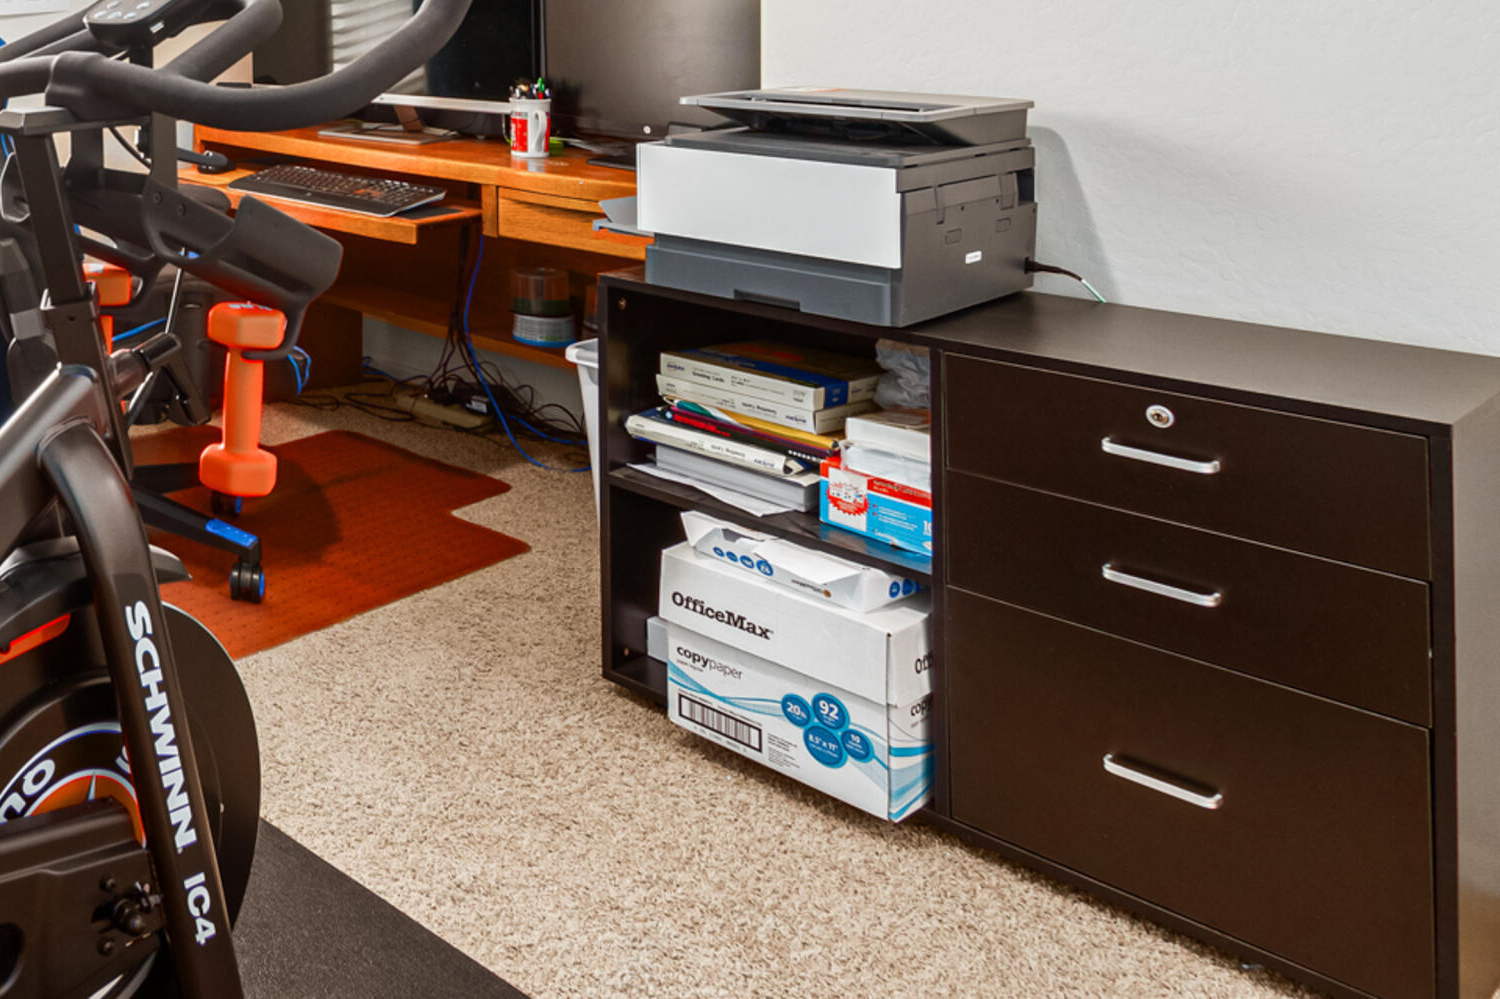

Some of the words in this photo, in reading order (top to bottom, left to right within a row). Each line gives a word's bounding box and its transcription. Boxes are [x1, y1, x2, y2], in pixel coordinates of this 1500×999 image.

[671, 591, 772, 641] OfficeMax
[819, 699, 840, 720] 92
[125, 600, 198, 850] SCHWINN
[184, 871, 217, 946] IC4
